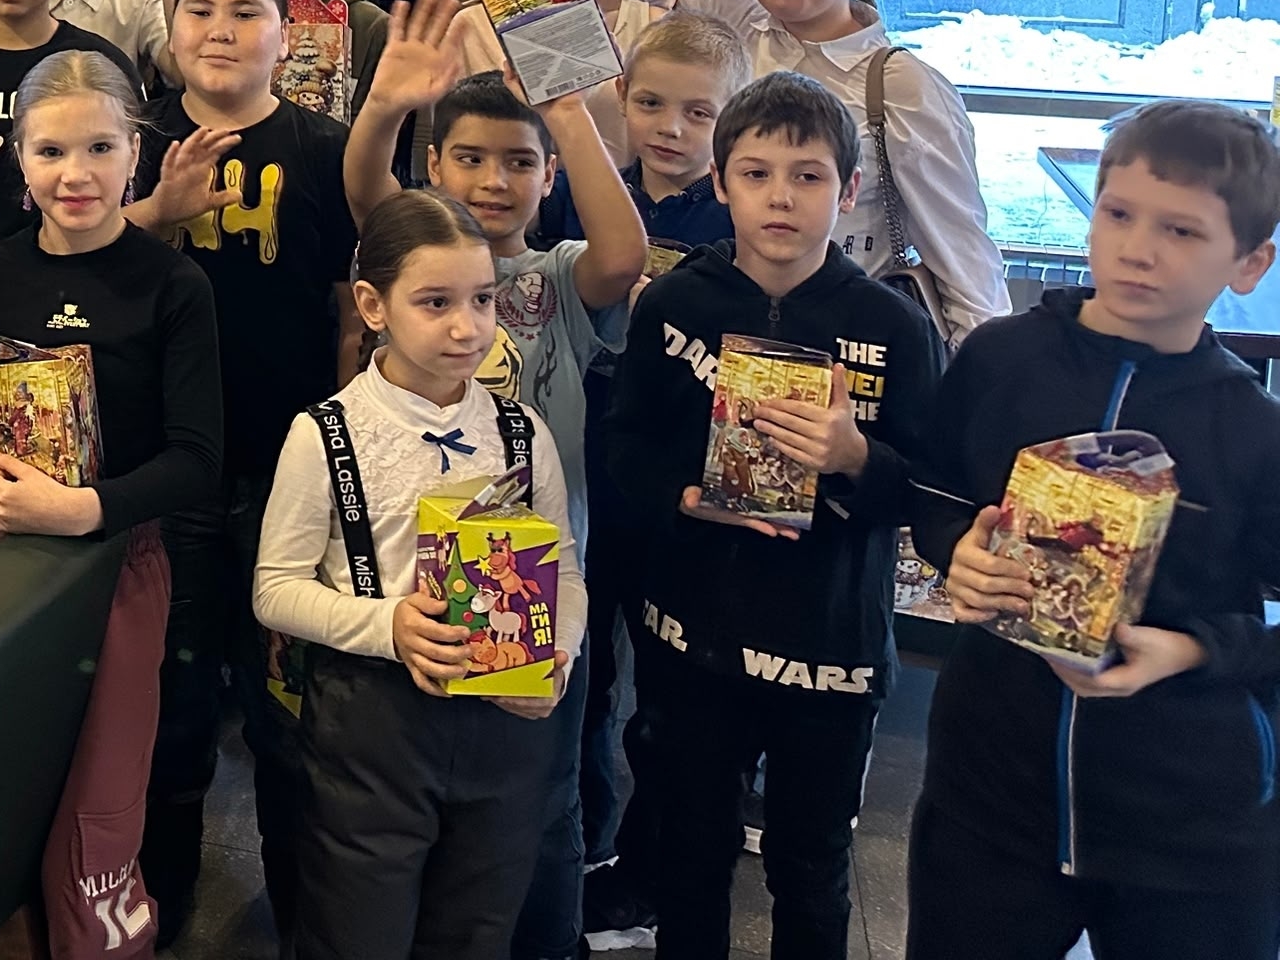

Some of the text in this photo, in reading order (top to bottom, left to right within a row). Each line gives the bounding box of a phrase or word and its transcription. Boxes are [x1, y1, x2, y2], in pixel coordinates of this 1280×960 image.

[663, 322, 720, 392] DAR
[836, 337, 887, 367] THE
[849, 399, 881, 421] HE
[334, 455, 362, 522] Lassie
[353, 555, 376, 598] Mish
[529, 602, 549, 615] МА
[742, 648, 873, 694] WARS
